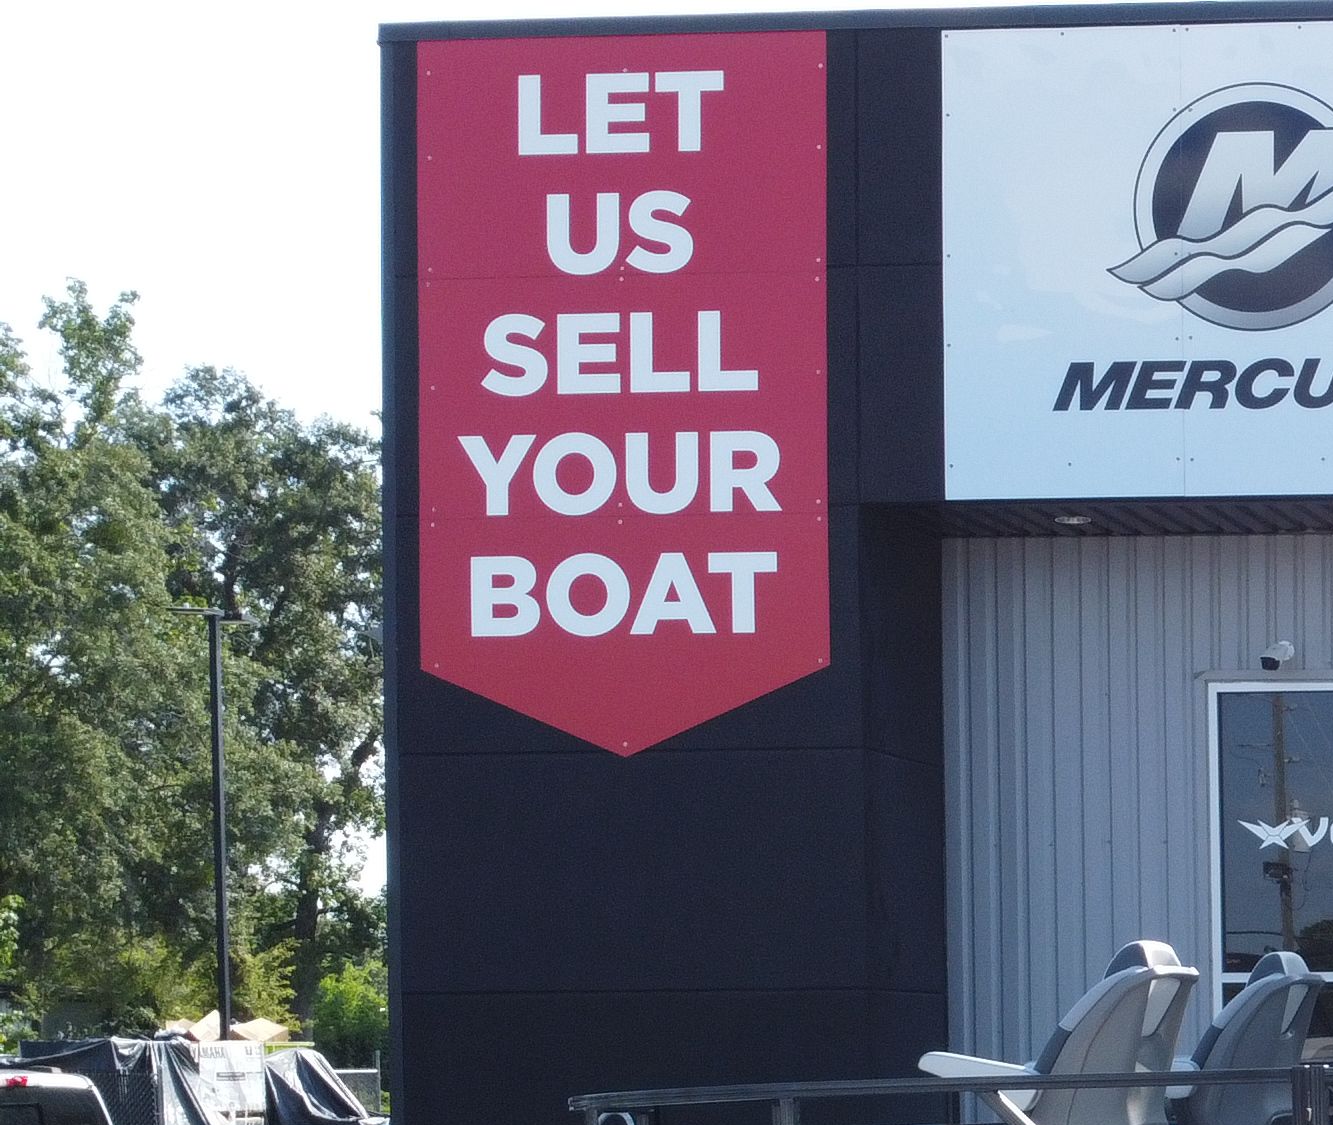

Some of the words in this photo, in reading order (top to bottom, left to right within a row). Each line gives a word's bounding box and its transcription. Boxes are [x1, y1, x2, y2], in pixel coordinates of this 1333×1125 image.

[518, 70, 724, 155] LET
[546, 190, 694, 275] US
[480, 310, 759, 397] SELL
[458, 430, 783, 516] YOUR
[470, 551, 778, 637] BOAT
